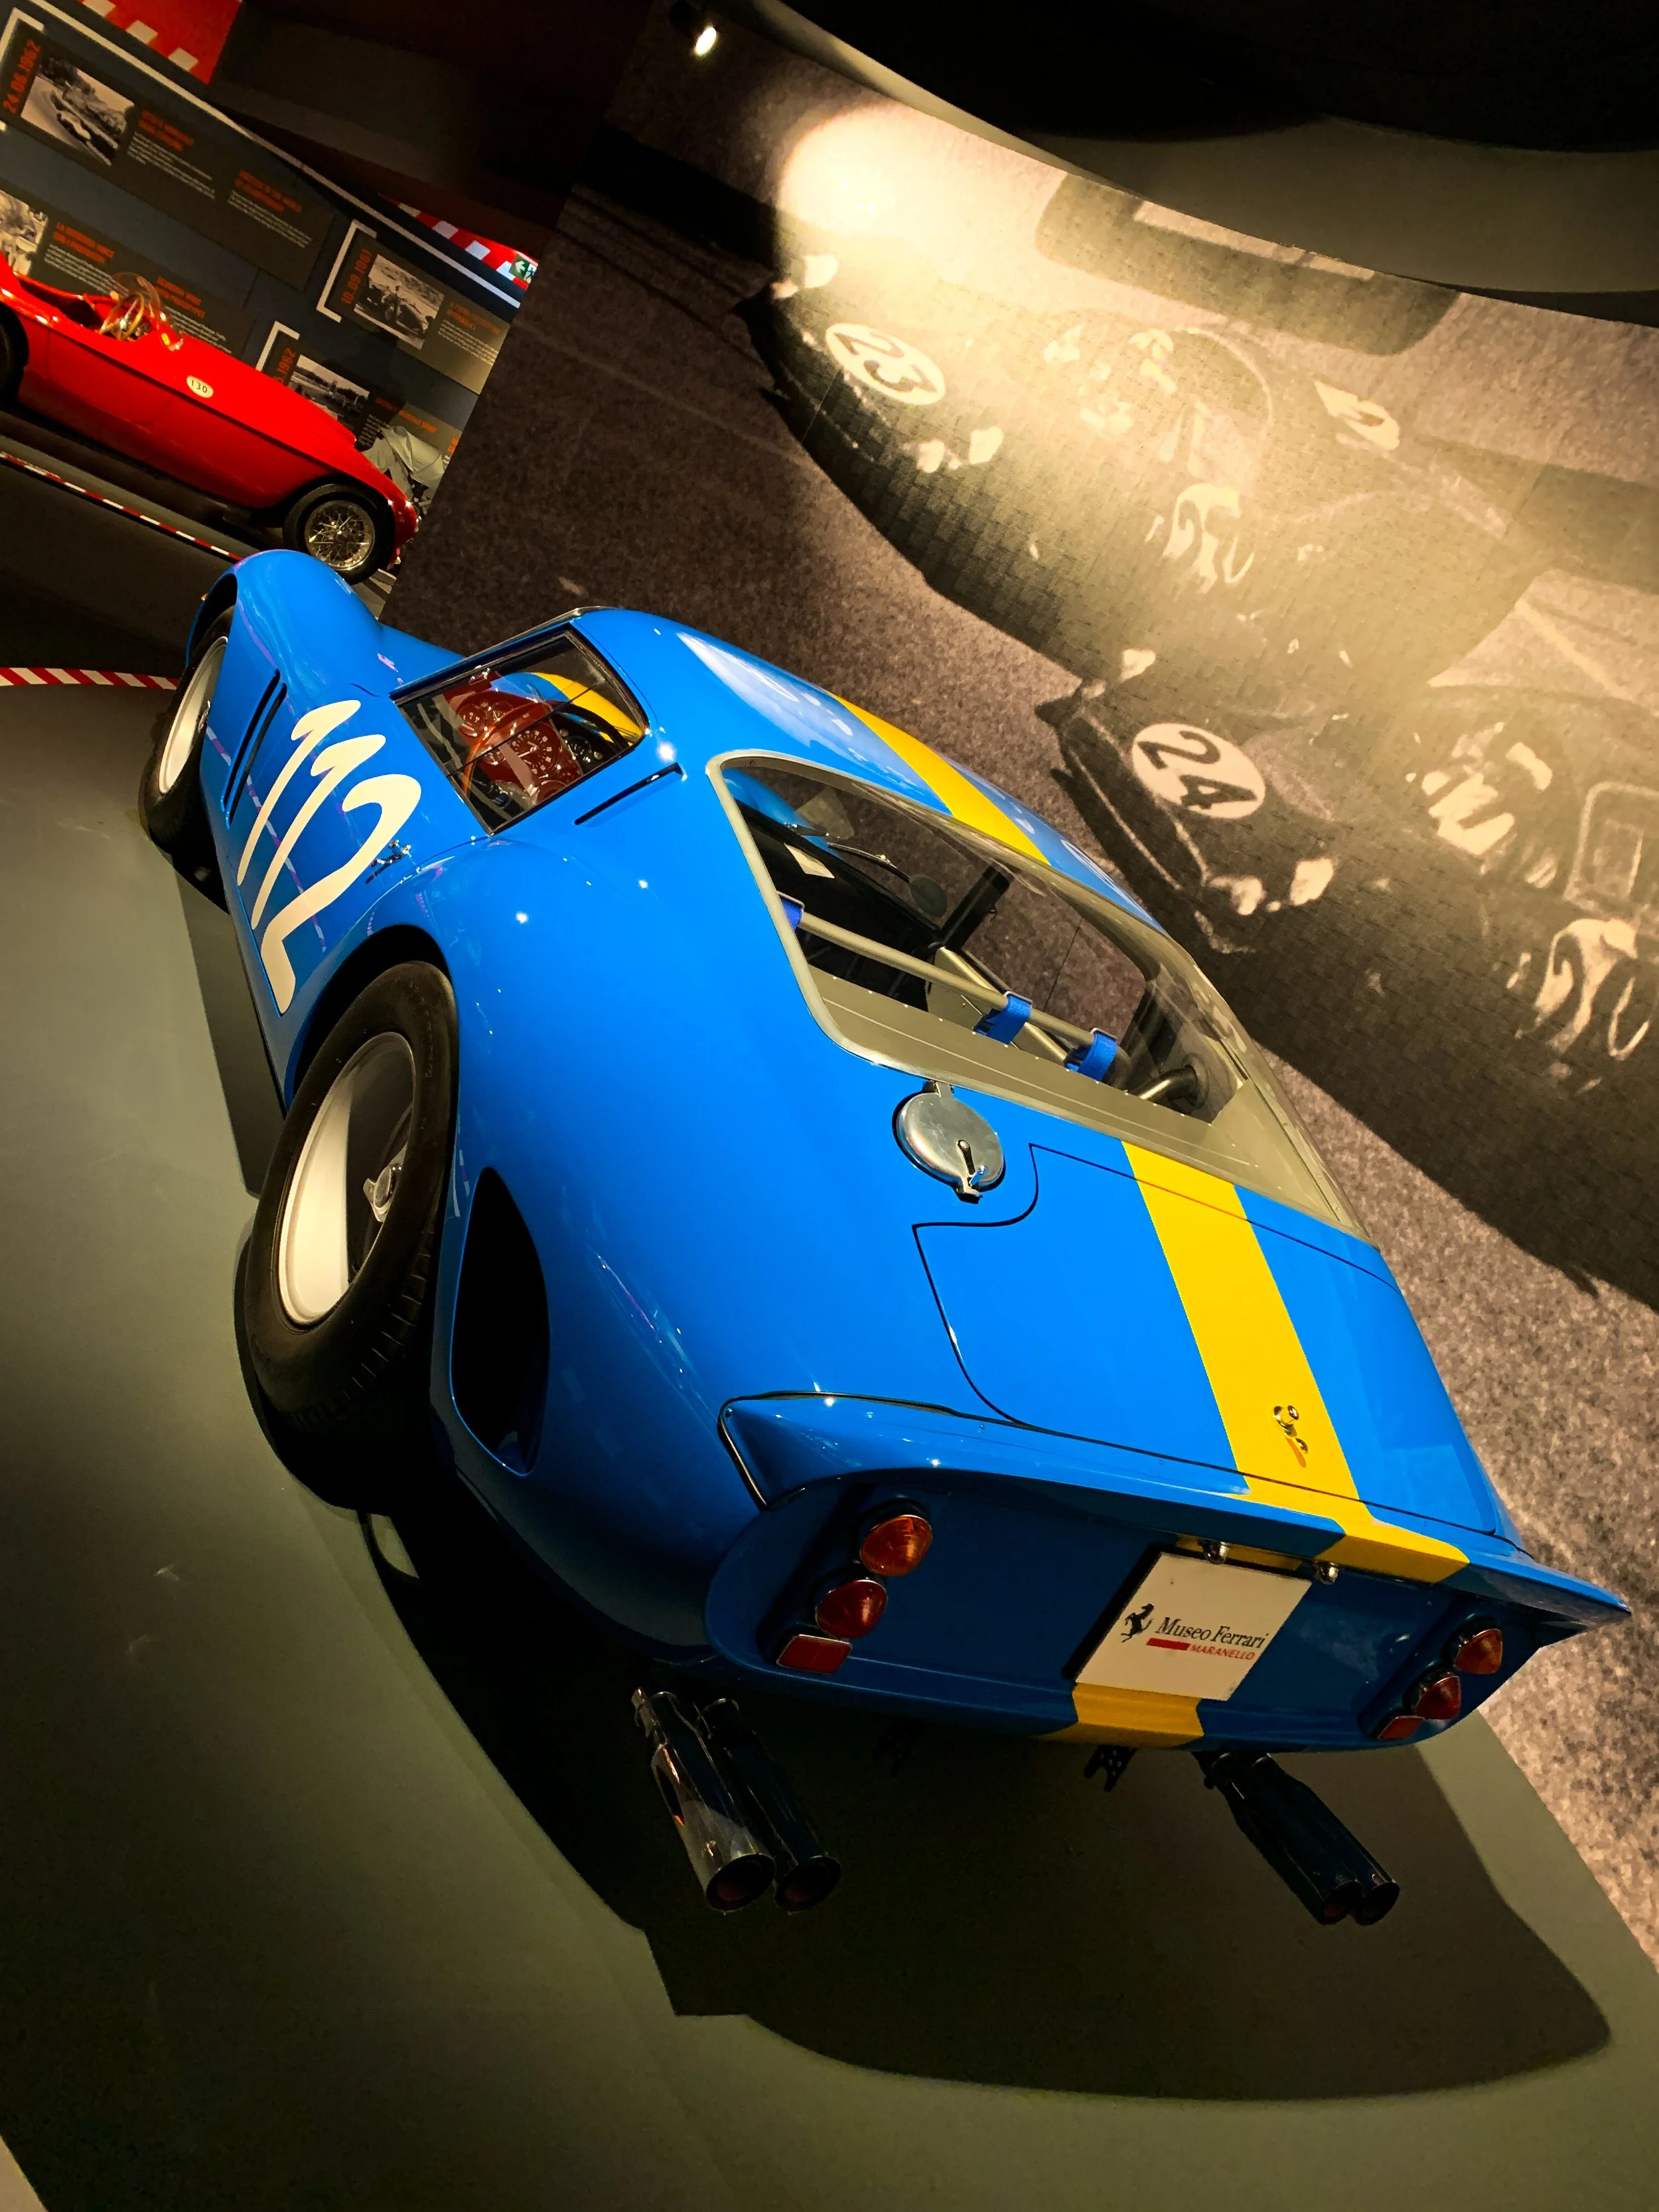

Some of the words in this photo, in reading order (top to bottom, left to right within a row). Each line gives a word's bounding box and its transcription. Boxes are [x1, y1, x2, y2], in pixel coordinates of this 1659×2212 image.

[191, 379, 208, 394] 130
[1137, 731, 1258, 810] 24
[237, 700, 421, 1014] 112
[1154, 1616, 1212, 1641] Museo
[1210, 1625, 1269, 1649] Ferrari
[1190, 1643, 1256, 1660] MARANELLO
